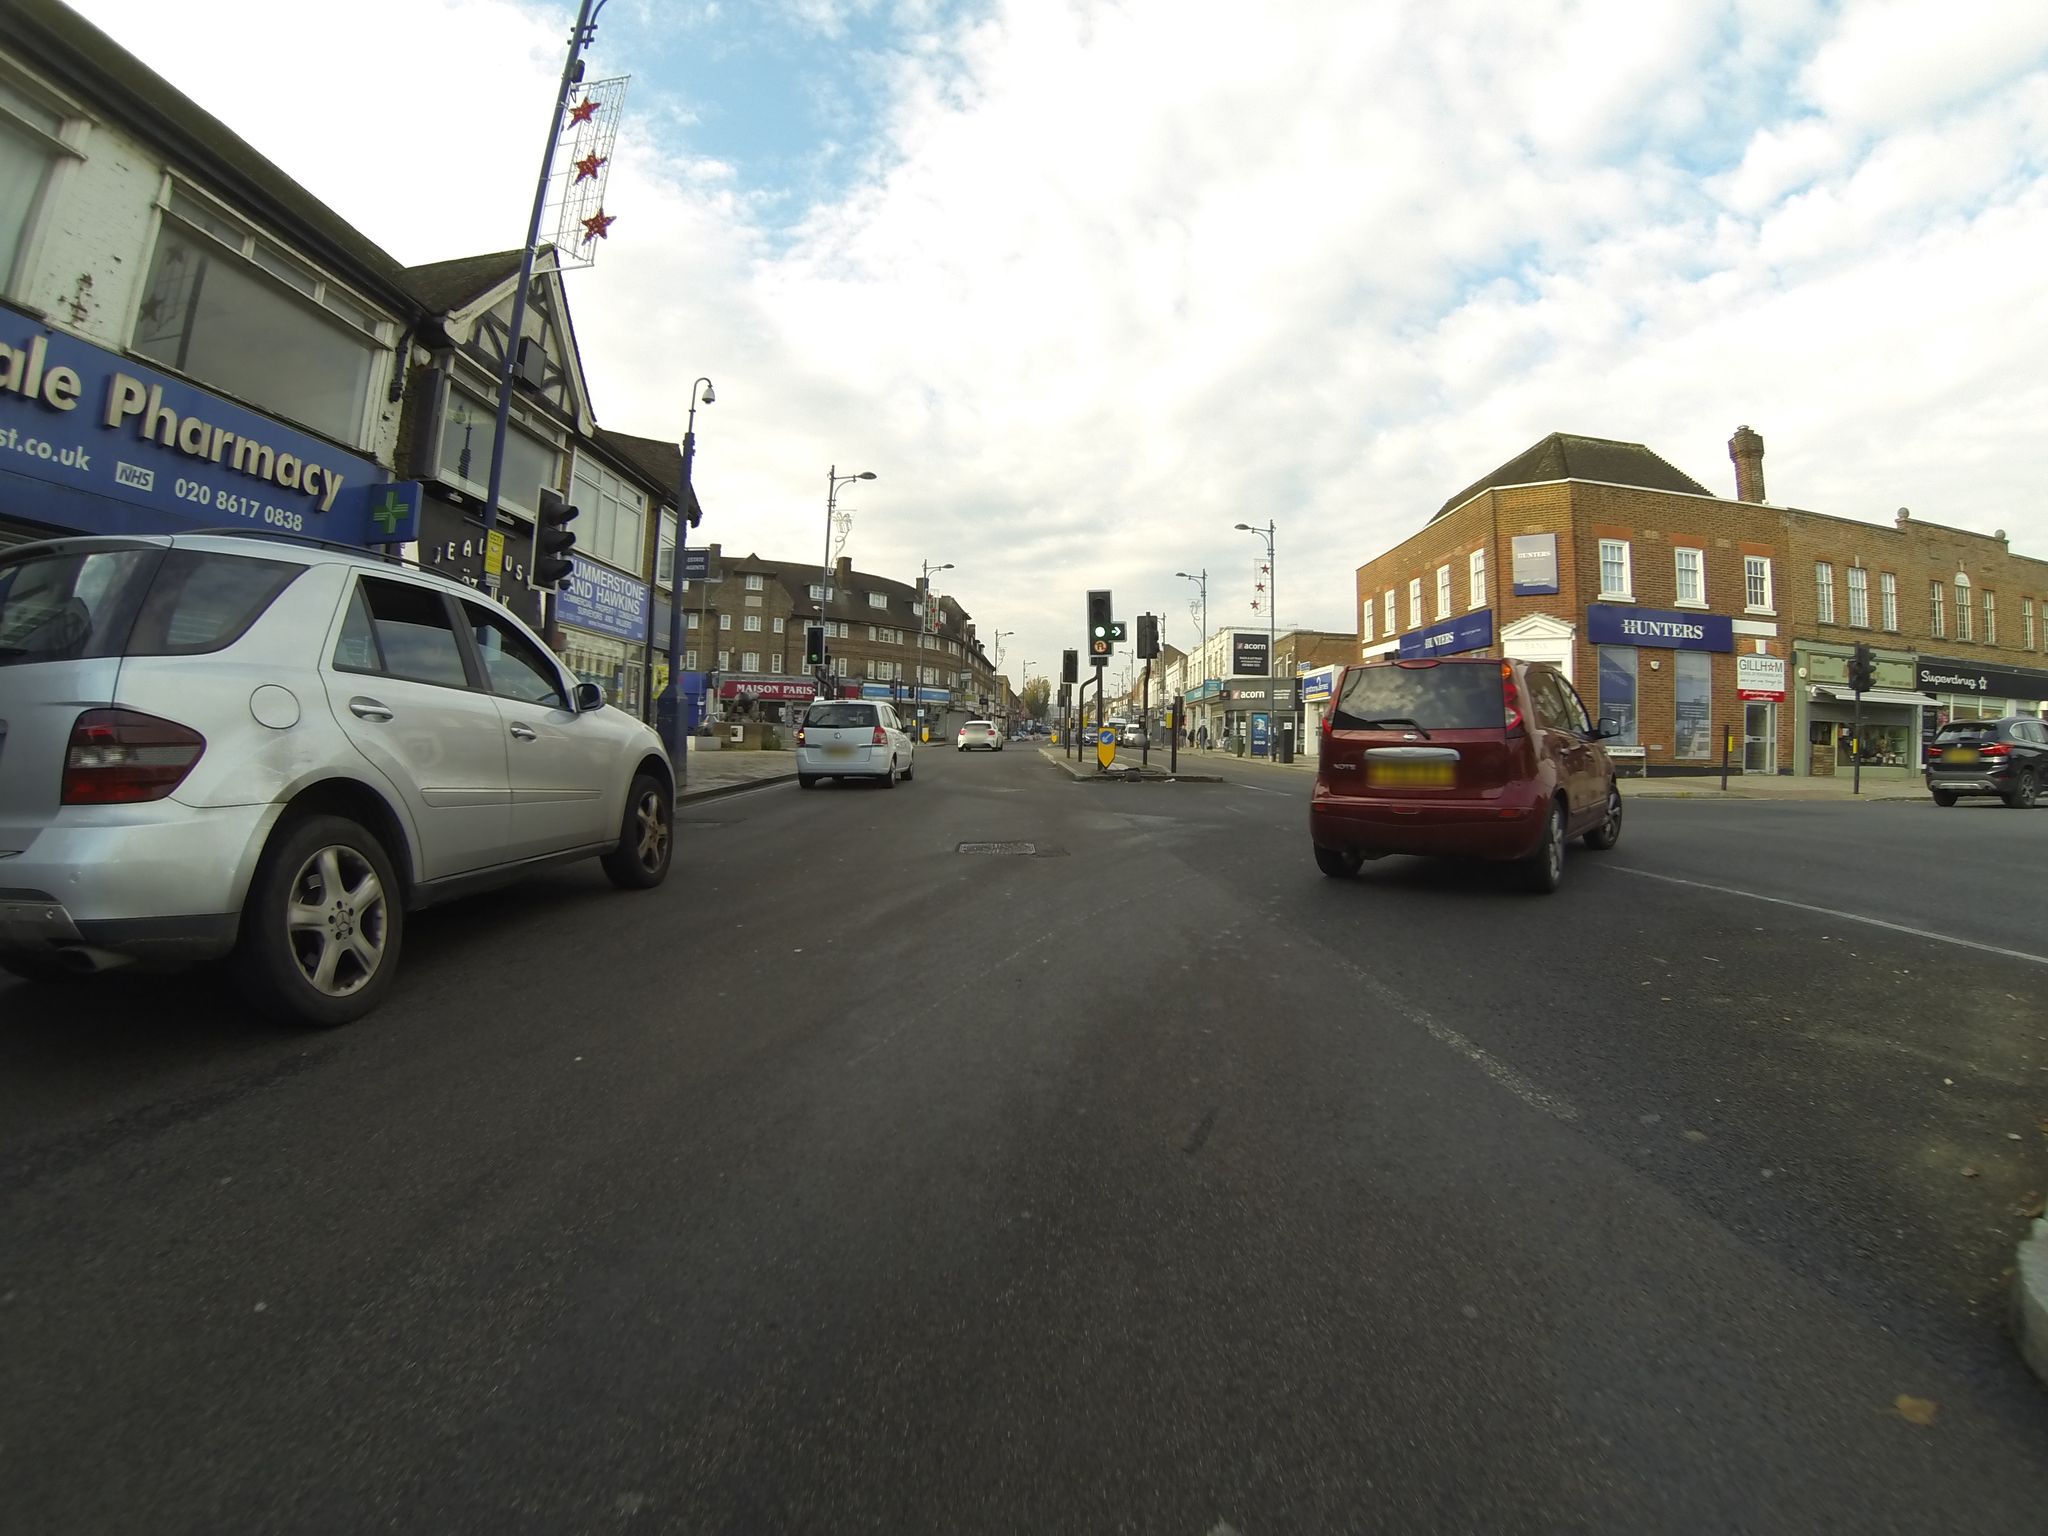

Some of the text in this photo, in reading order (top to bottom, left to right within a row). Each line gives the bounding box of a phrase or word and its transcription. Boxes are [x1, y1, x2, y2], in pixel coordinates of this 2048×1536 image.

[104, 372, 344, 512] Pharmacy
[119, 467, 151, 487] NHS
[175, 478, 302, 531] 020 8617 0838
[571, 558, 645, 601] UMMERSTONE
[568, 577, 640, 615] AND HAWKINS
[1621, 619, 1704, 640] HUNTERS
[1244, 642, 1266, 650] acorn
[736, 684, 779, 694] MAISON
[1921, 670, 1976, 689] Superdrug
[1240, 690, 1265, 699] acorn
